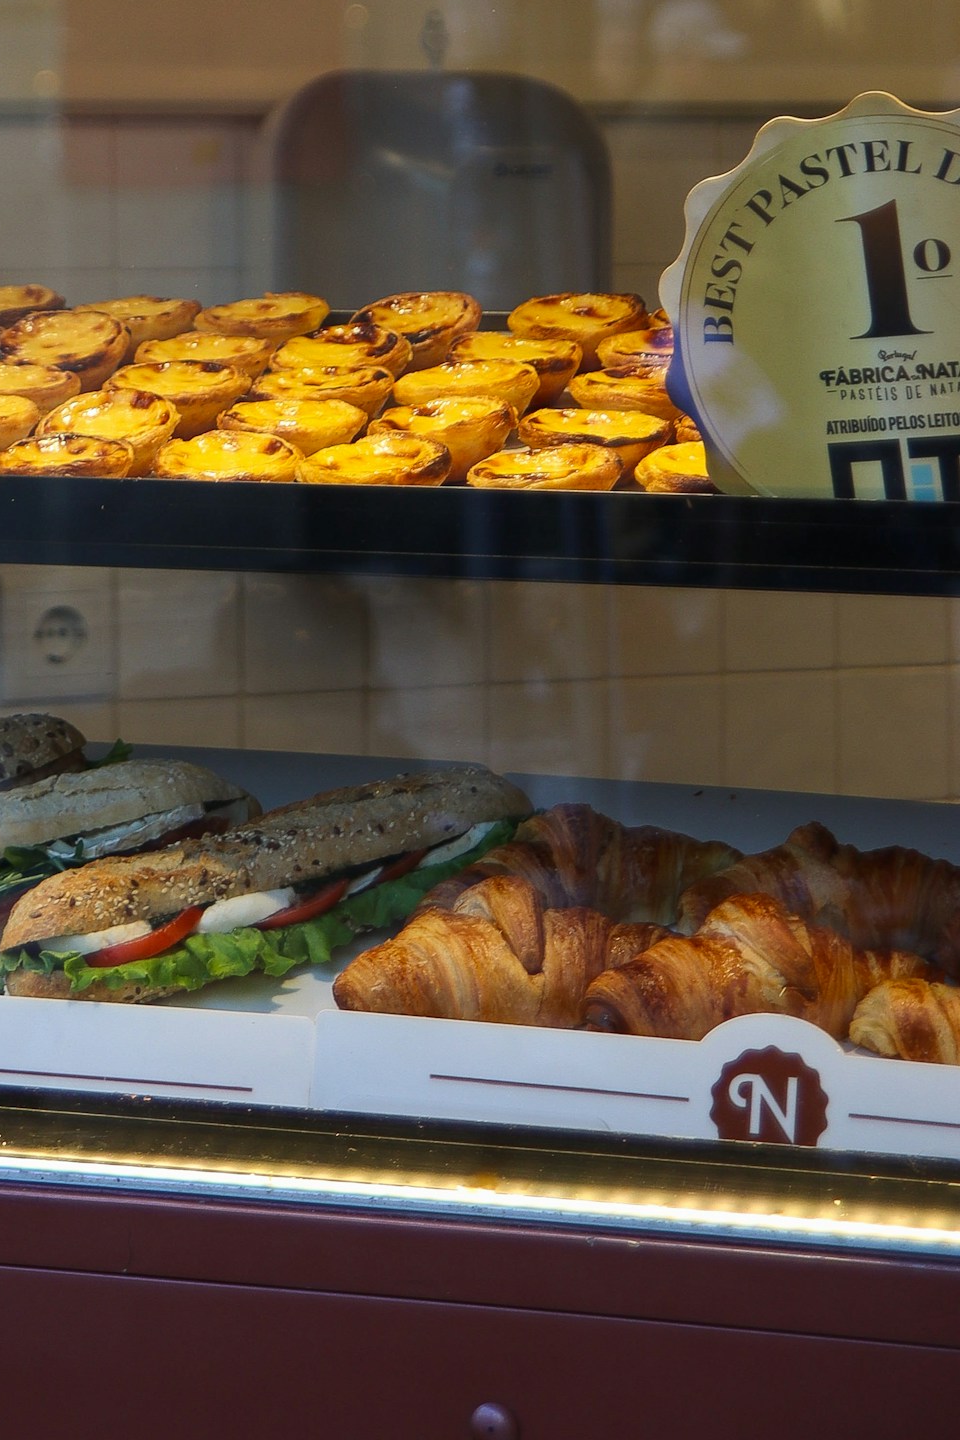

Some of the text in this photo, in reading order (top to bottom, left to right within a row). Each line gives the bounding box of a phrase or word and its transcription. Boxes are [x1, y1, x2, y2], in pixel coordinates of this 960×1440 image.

[703, 221, 756, 346] BEST
[744, 139, 923, 228] PASTEL
[878, 349, 917, 362] Portugal
[819, 365, 910, 387] FÁBRICA
[915, 360, 960, 380] NAT
[840, 385, 898, 401] PASTÉIS
[905, 384, 922, 400] DE
[826, 411, 960, 435] ATRIBUÍDO PELOS LEITO
[728, 1073, 798, 1145] N
